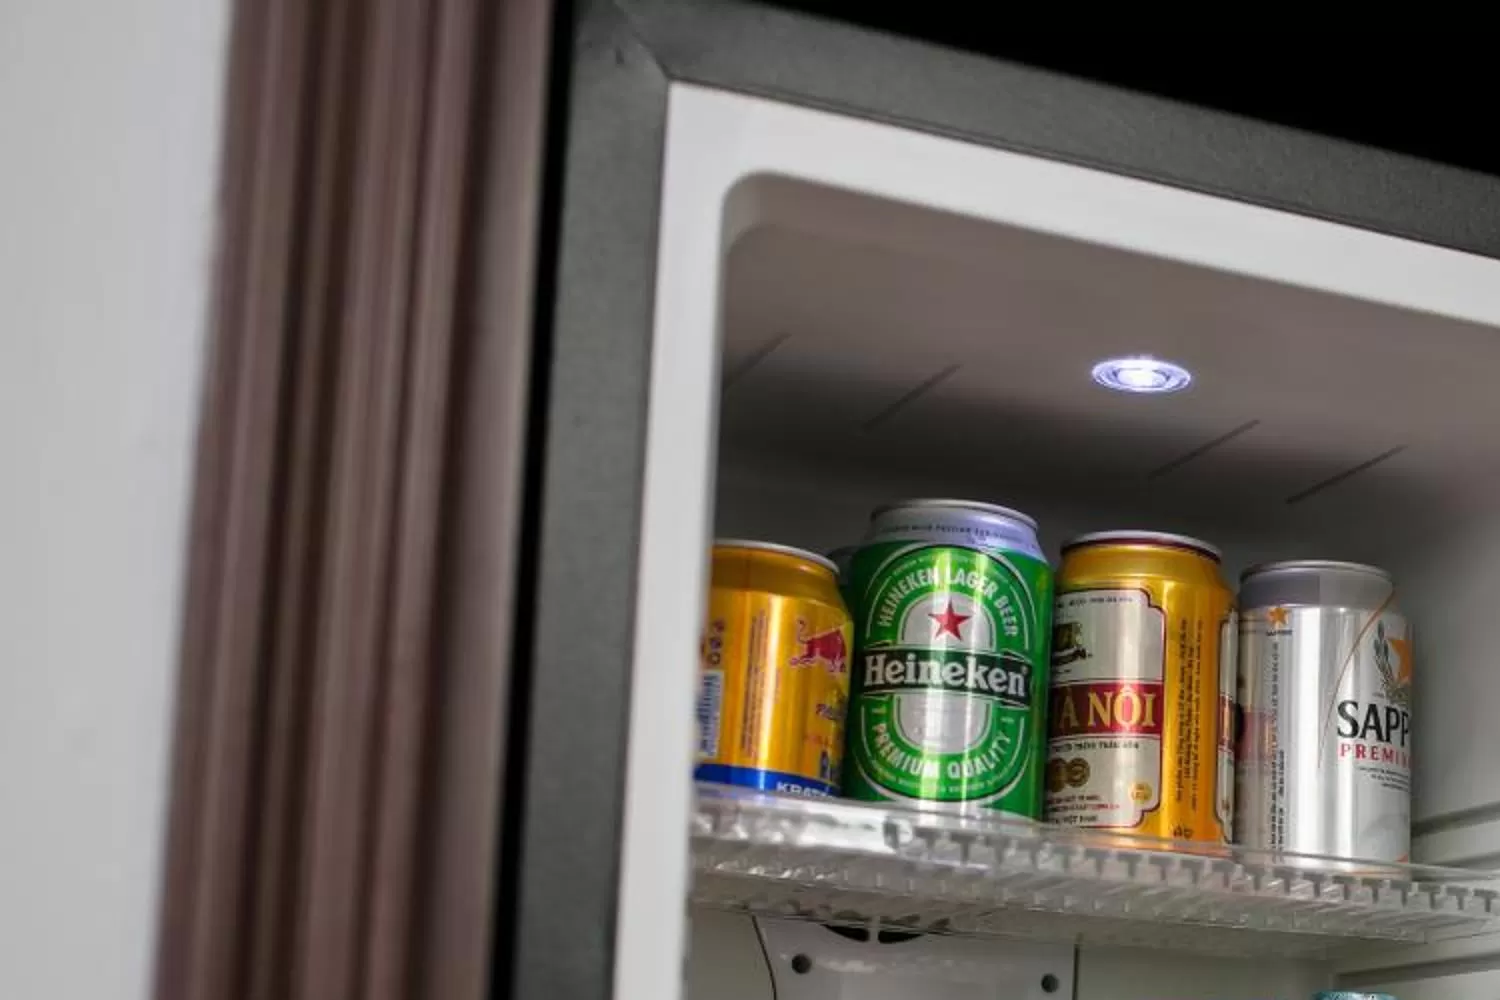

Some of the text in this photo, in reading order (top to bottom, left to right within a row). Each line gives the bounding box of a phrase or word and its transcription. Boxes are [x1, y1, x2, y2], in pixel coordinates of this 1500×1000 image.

[877, 567, 1019, 637] HEINEKEN LAGER BEER
[863, 654, 1030, 698] Heineken
[872, 722, 1011, 779] PREMIUM QUALITY
